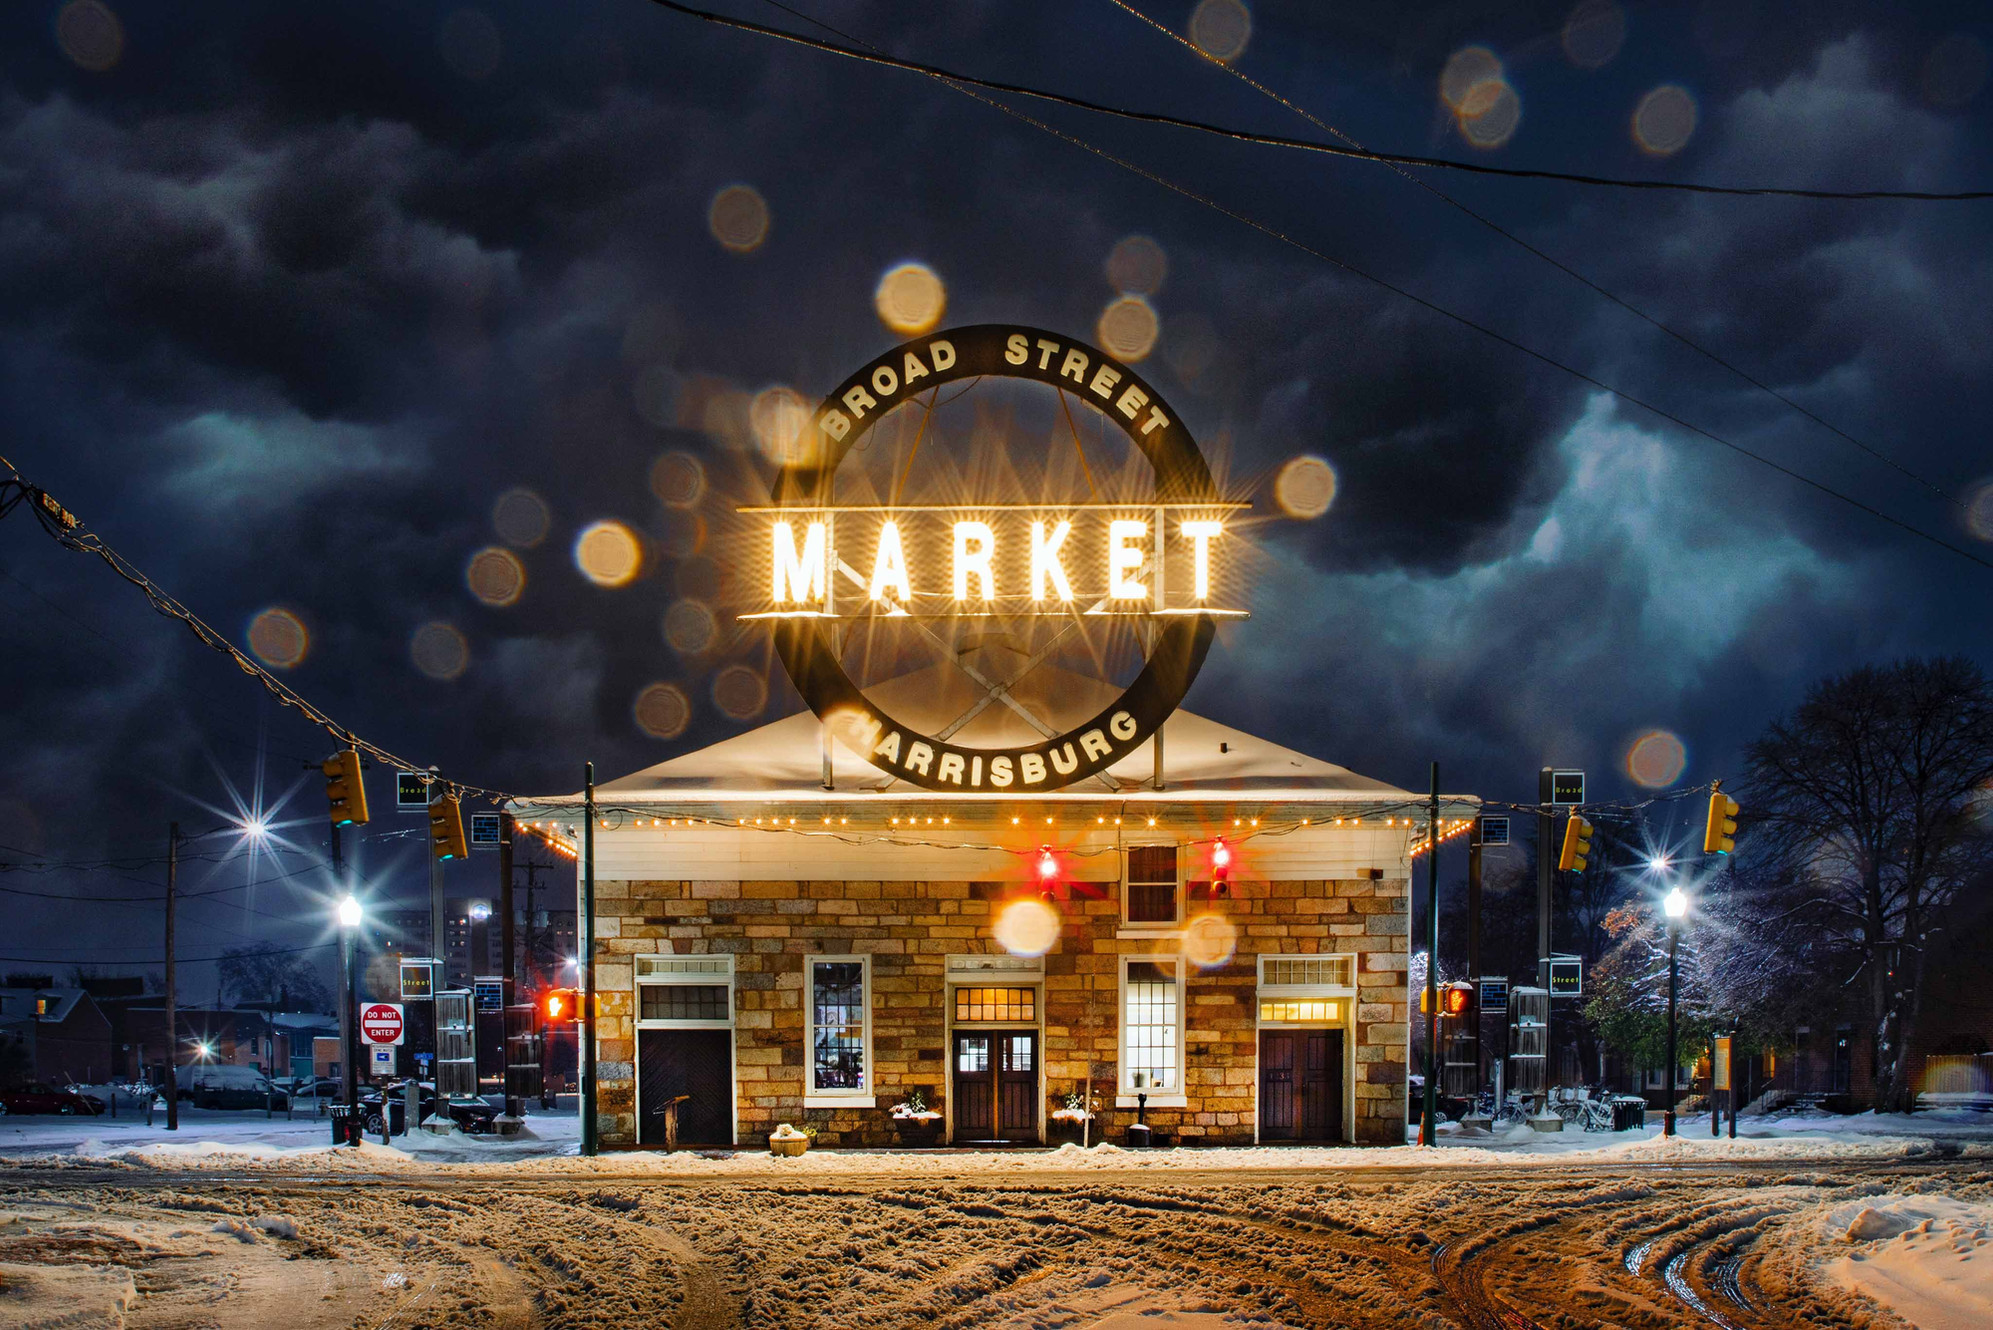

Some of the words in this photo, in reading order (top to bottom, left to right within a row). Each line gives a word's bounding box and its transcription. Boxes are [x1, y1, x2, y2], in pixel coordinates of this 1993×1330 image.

[820, 340, 957, 442] BROAD
[1004, 334, 1169, 436] STREET
[772, 520, 1222, 603] MARKET
[382, 1011, 396, 1019] NOT
